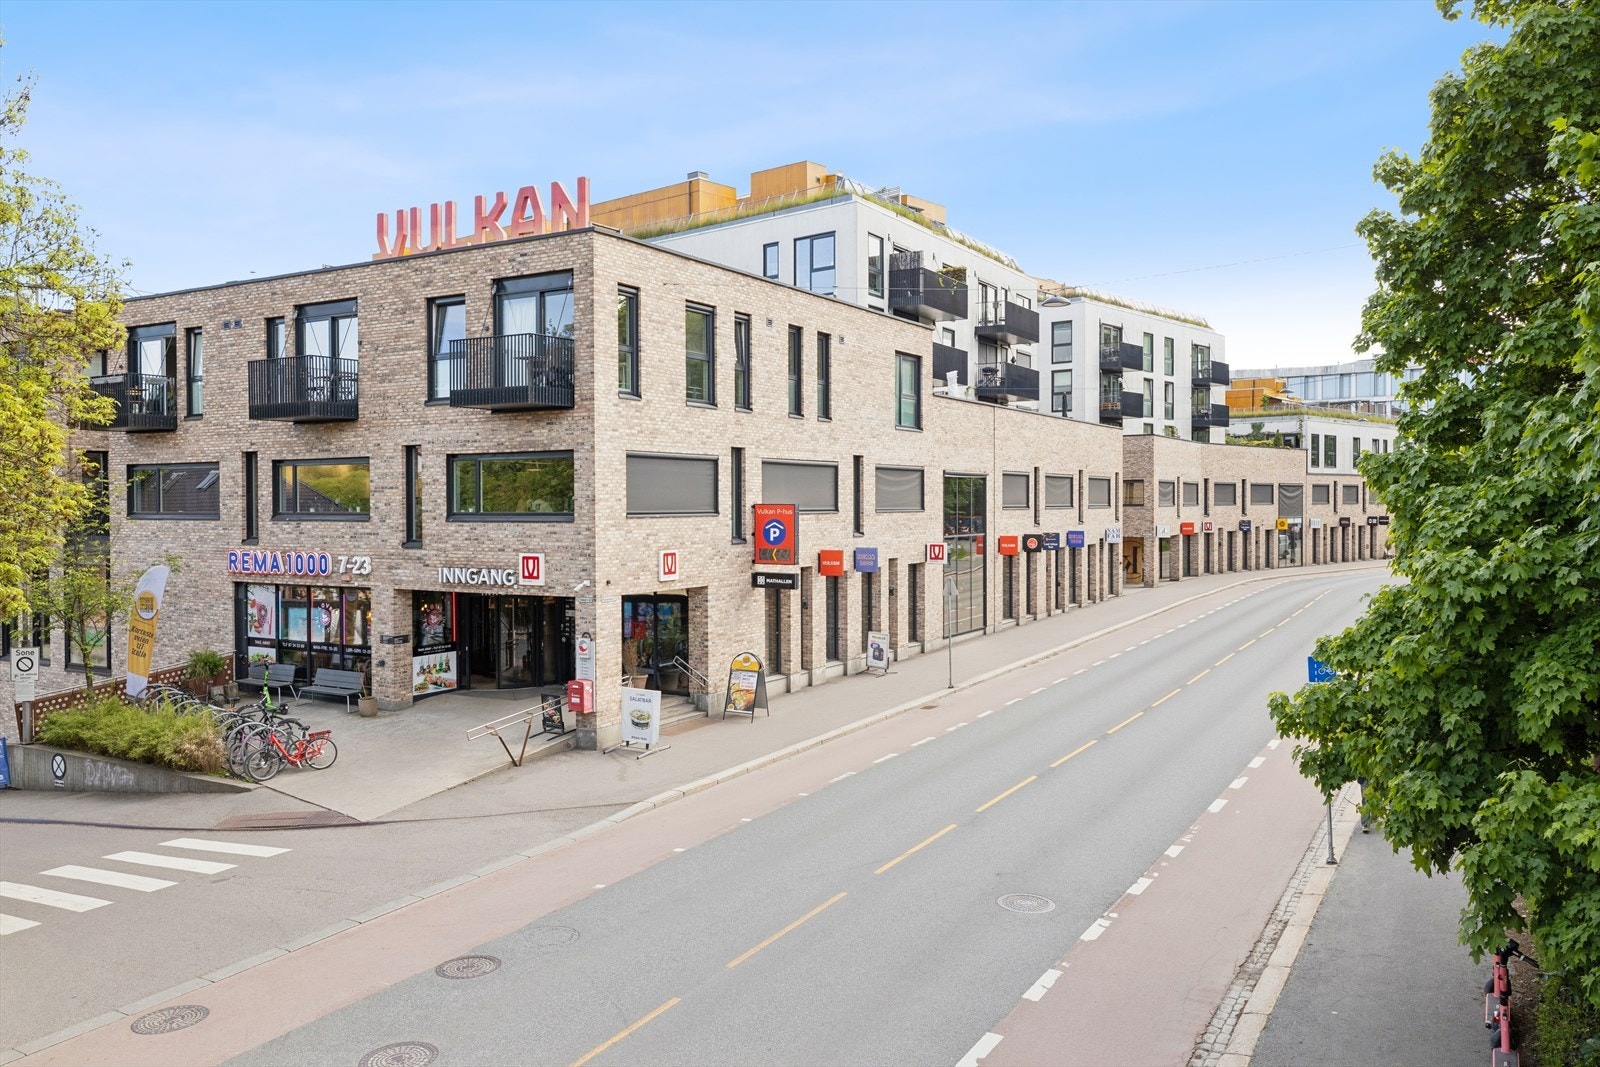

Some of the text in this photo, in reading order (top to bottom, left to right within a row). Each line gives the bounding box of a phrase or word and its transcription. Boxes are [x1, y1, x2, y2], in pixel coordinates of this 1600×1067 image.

[376, 176, 590, 256] VULKAN
[769, 527, 780, 541] P
[227, 550, 332, 577] REMA 1000
[338, 556, 372, 575] 7-23
[438, 567, 515, 586] INNGANG
